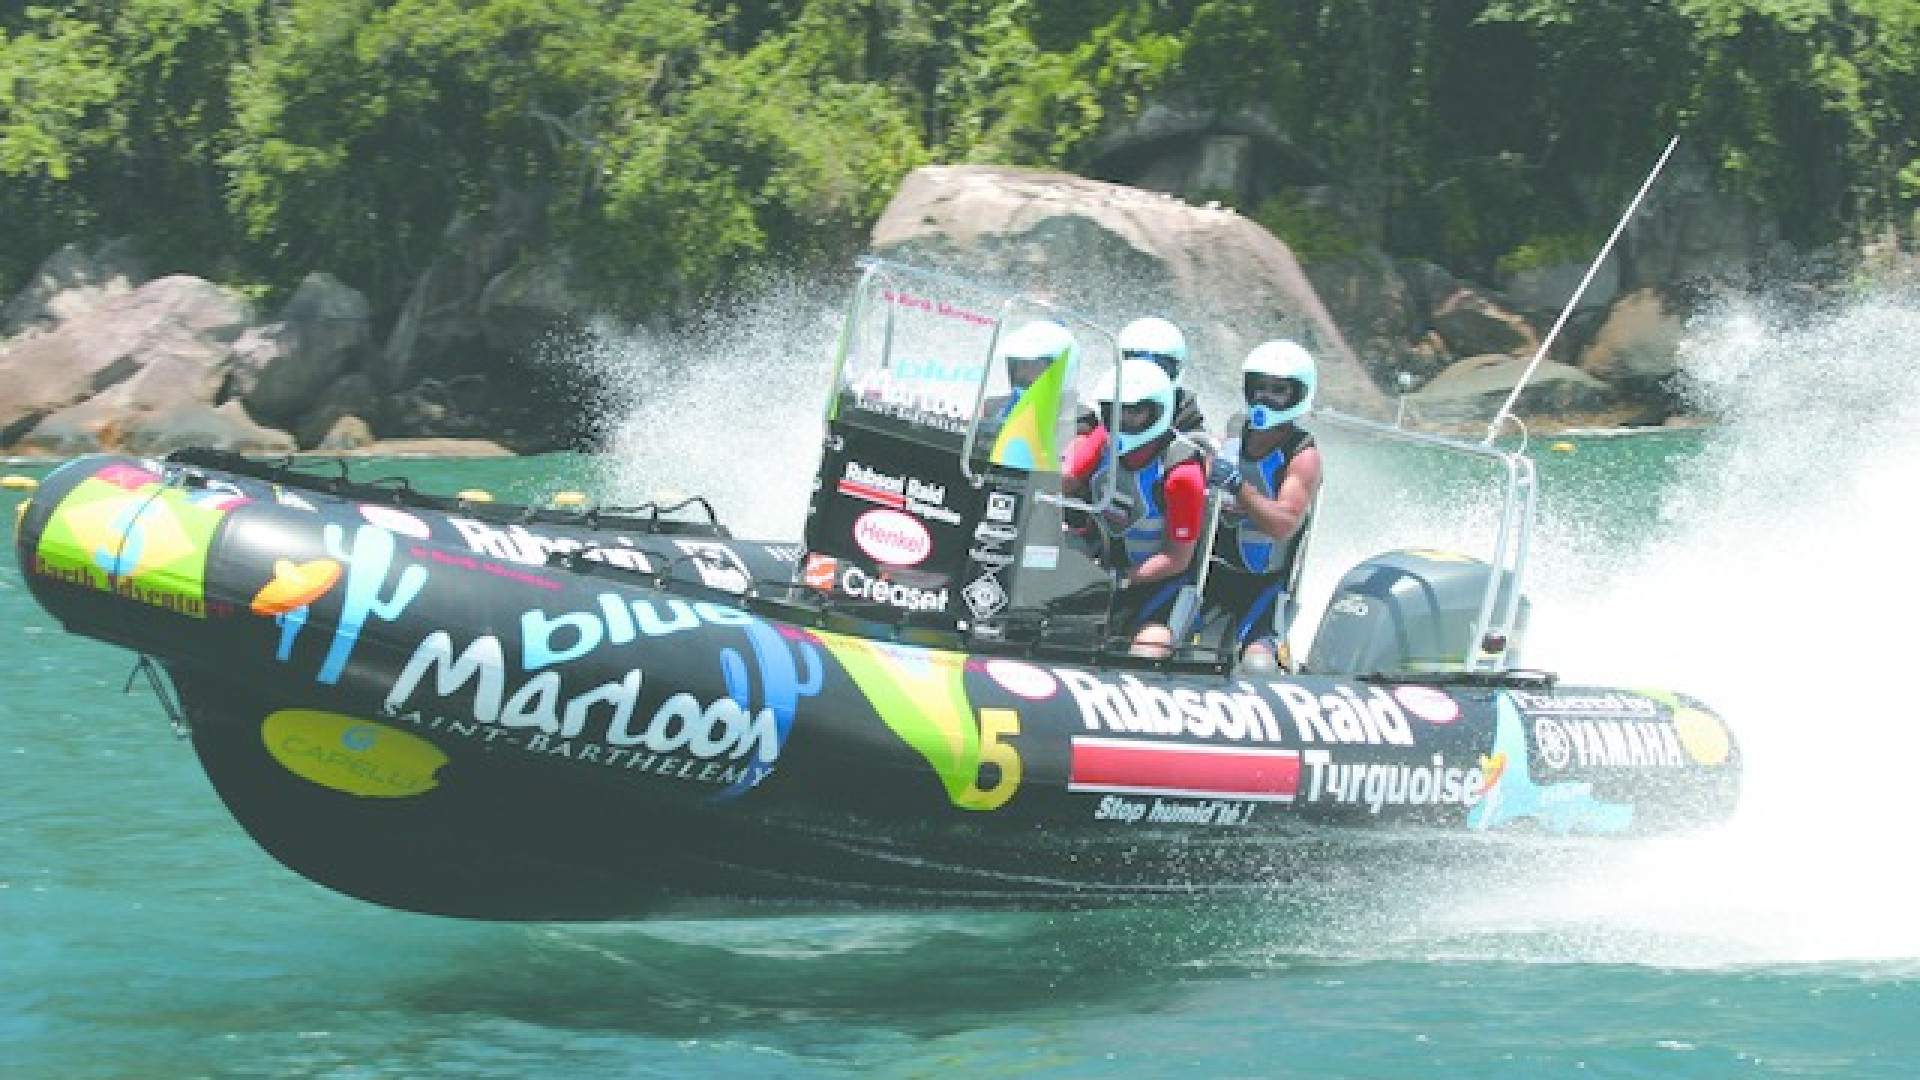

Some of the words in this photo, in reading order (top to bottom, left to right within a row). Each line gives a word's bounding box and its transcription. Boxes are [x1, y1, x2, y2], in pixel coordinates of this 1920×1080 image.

[845, 461, 904, 493] Rubson
[908, 476, 946, 505] Raid
[859, 520, 925, 553] Henkel
[521, 592, 753, 671] blue
[1053, 670, 1282, 742] Rubson
[1270, 683, 1414, 745] Raid
[975, 709, 1021, 811] 5
[1562, 719, 1685, 767] YAMAHA
[1303, 747, 1484, 814] Turquoise
[1094, 795, 1146, 824] Stop
